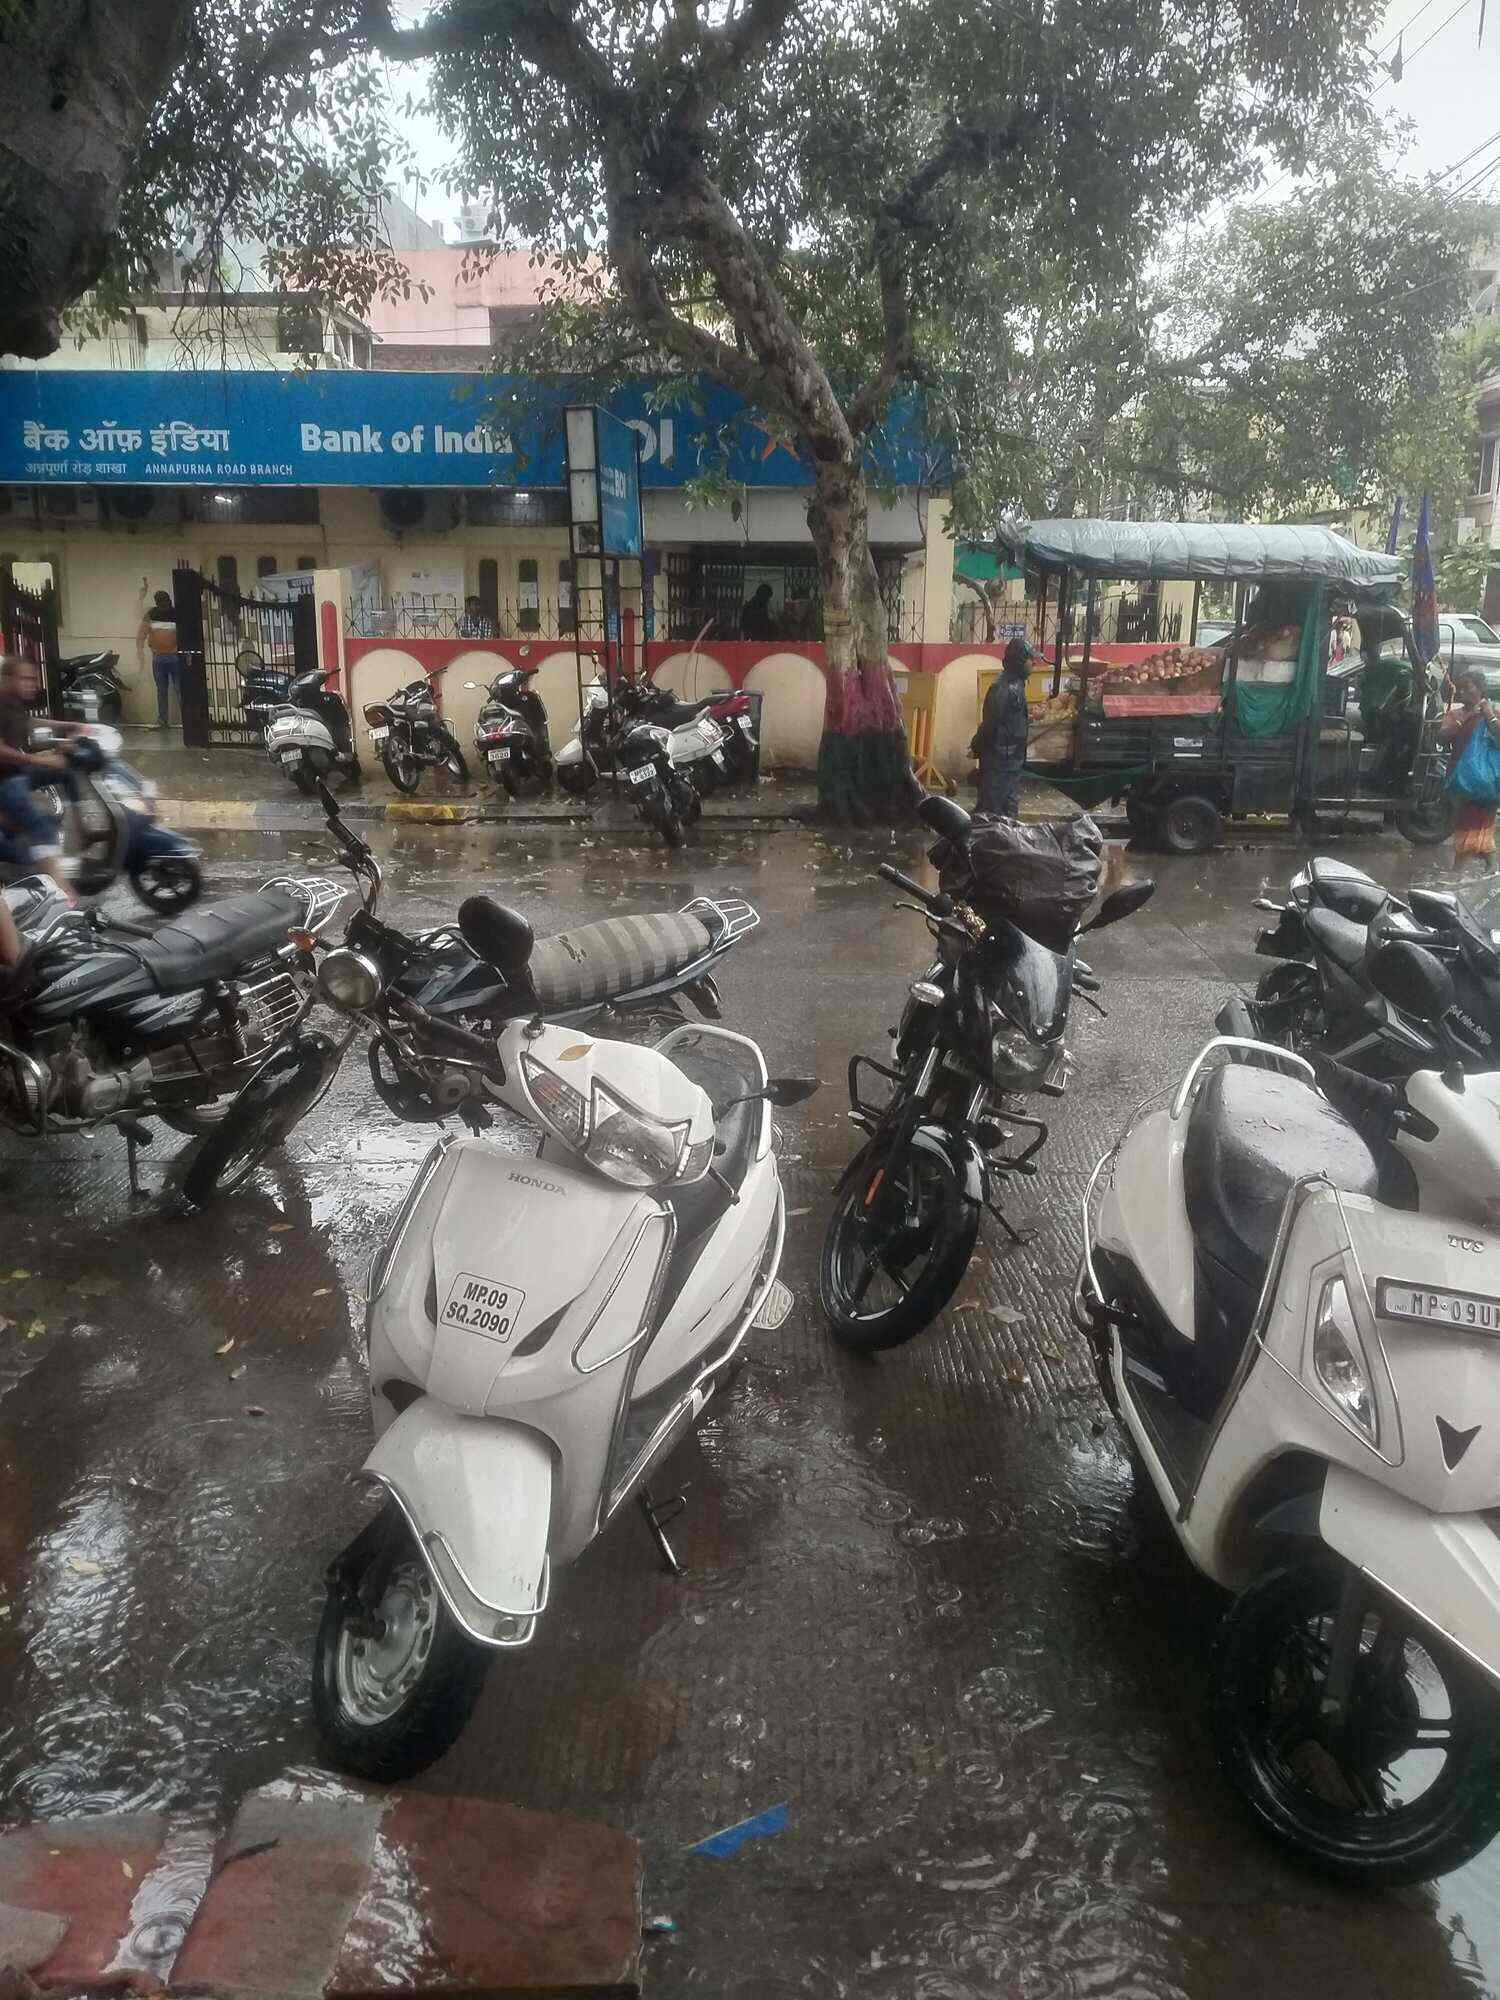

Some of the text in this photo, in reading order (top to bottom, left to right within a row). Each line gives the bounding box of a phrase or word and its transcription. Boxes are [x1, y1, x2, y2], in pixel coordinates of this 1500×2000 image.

[23, 420, 70, 451] बैंक
[149, 421, 230, 457] इंडिया
[300, 423, 513, 454] Bank of India
[95, 463, 128, 474] शाखा
[145, 463, 294, 476] ANNAPURNA ROAD BRANCH
[508, 1171, 568, 1197] HONDA
[1447, 1234, 1484, 1253] TVS
[463, 1281, 508, 1310] MP.09
[446, 1301, 510, 1335] SQ.2090
